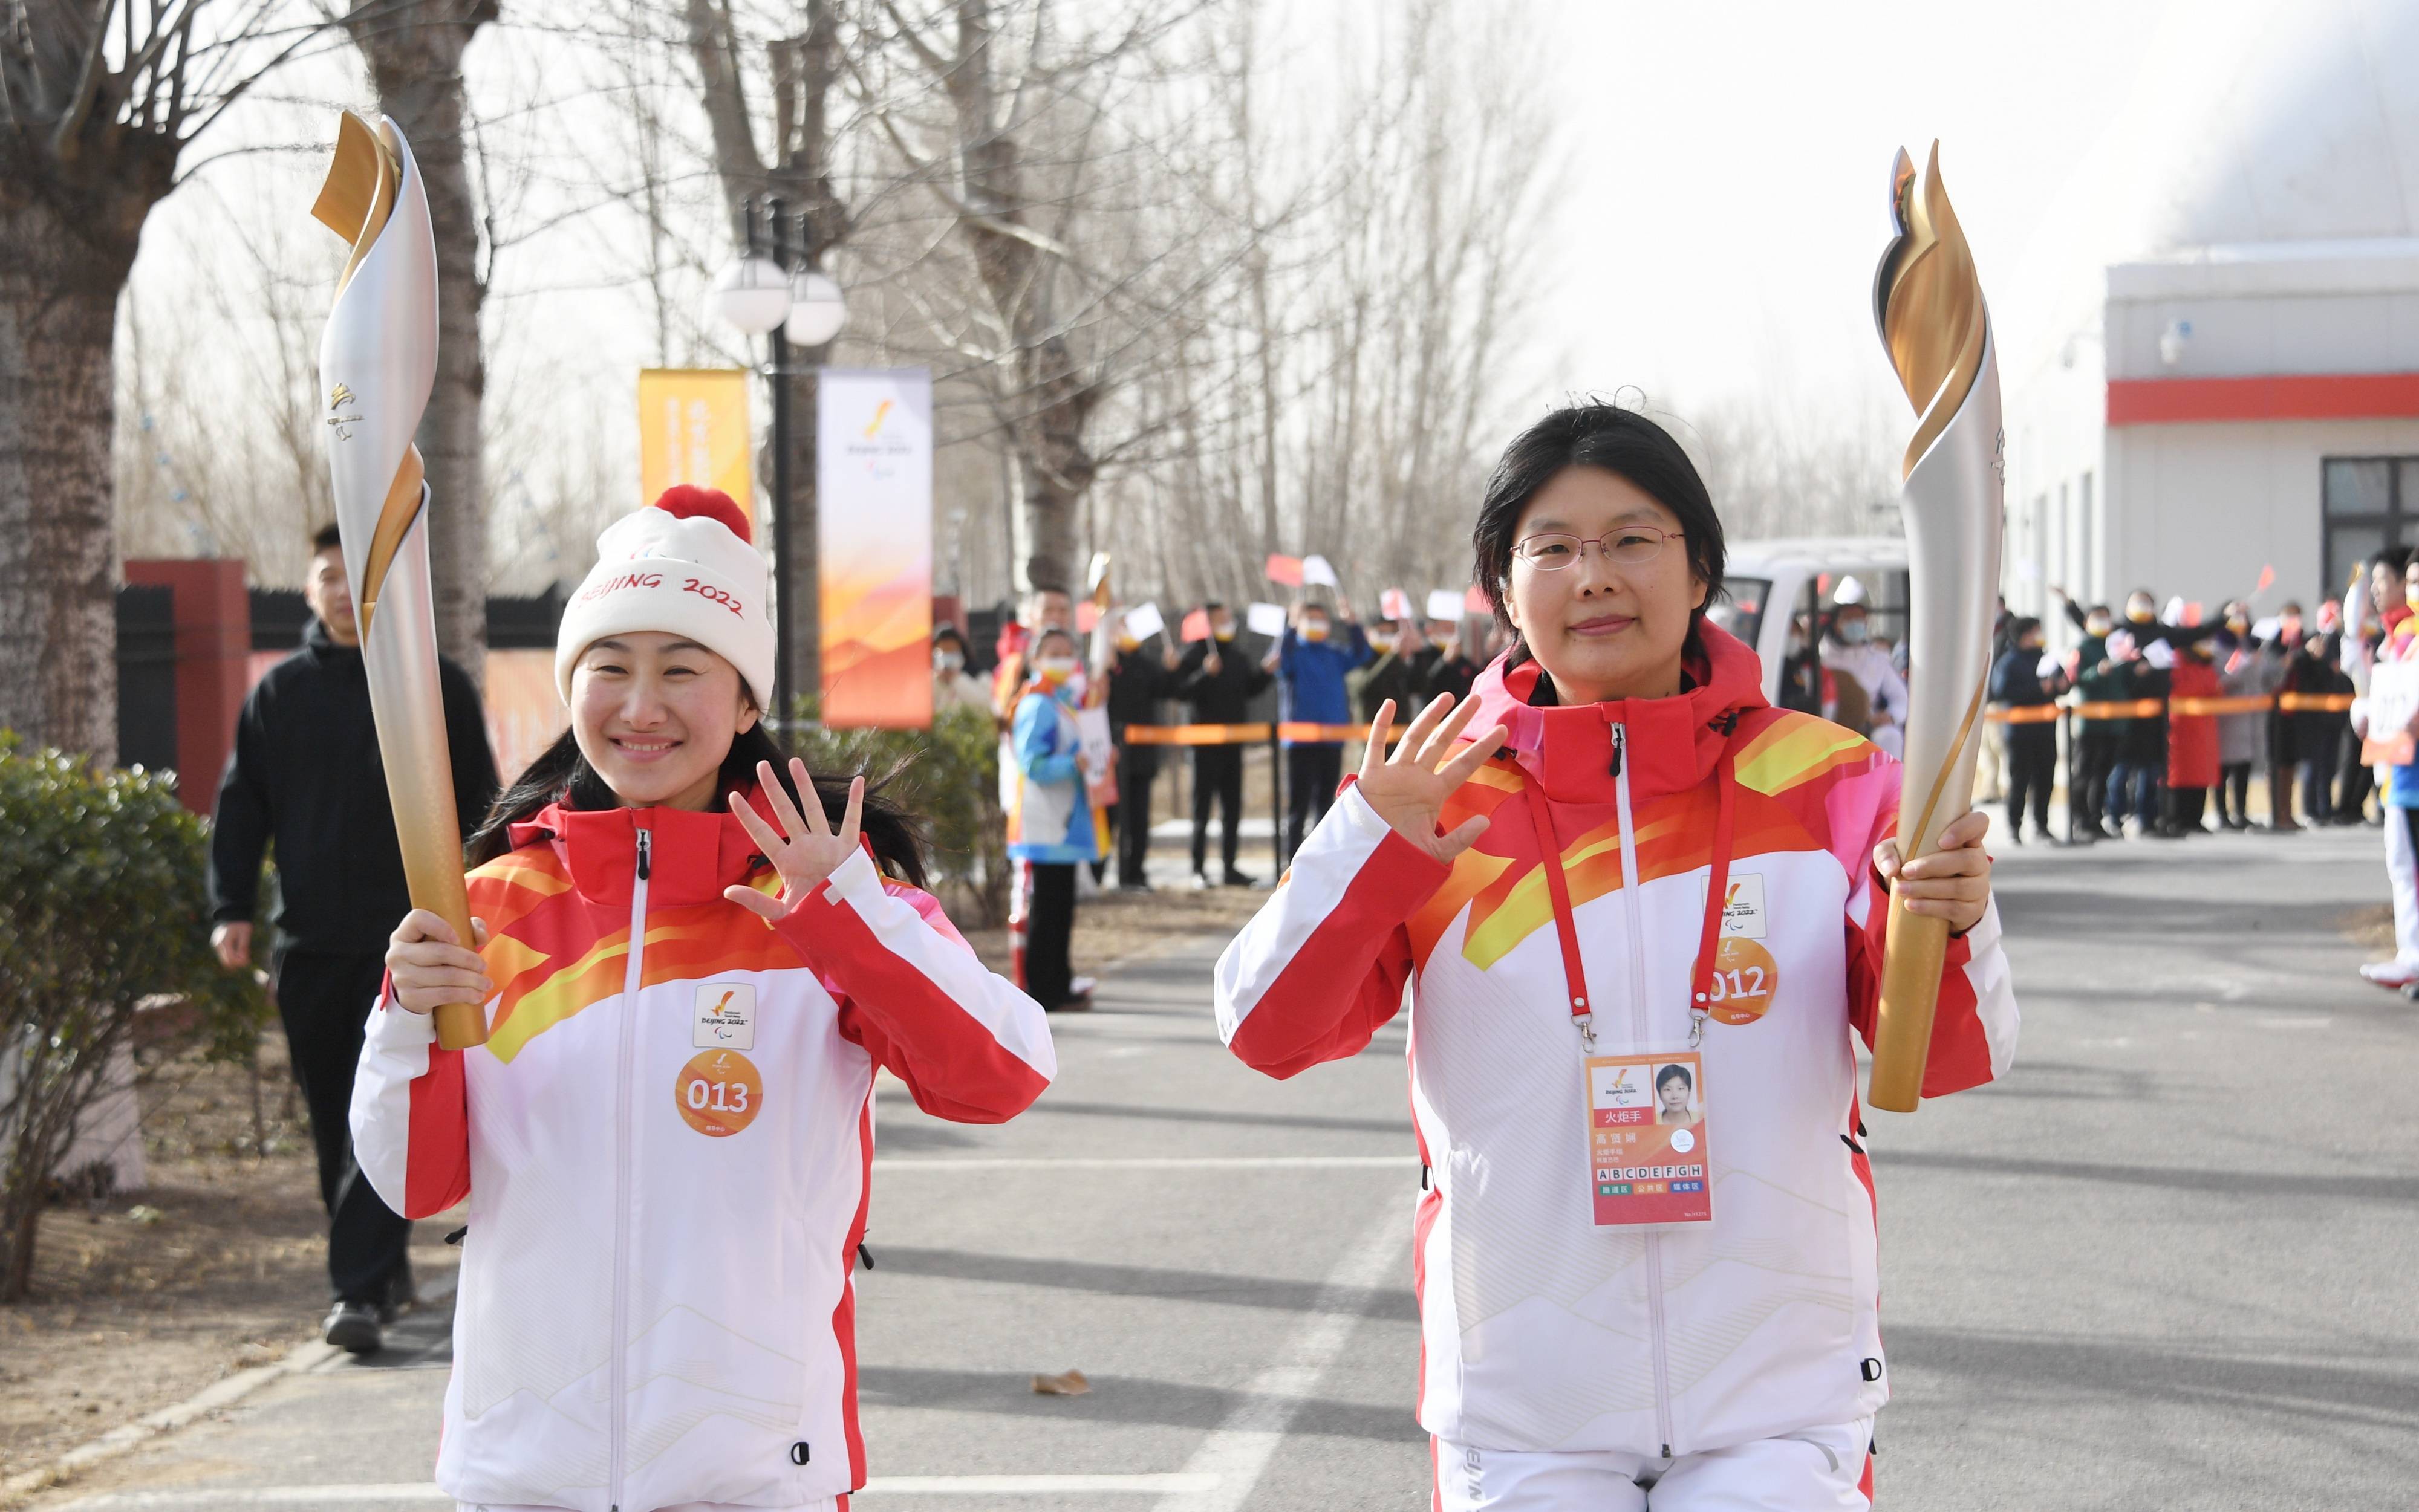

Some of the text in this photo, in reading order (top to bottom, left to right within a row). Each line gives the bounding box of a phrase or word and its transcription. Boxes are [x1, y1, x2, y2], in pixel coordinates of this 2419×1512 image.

[683, 579, 744, 620] 2022
[1709, 966, 1767, 1001] 012
[687, 1079, 749, 1112] 013
[1606, 1111, 1642, 1123] 火炬手
[1600, 1166, 1699, 1179] A B C D E F G H
[1463, 1449, 1482, 1512] EIJIN
